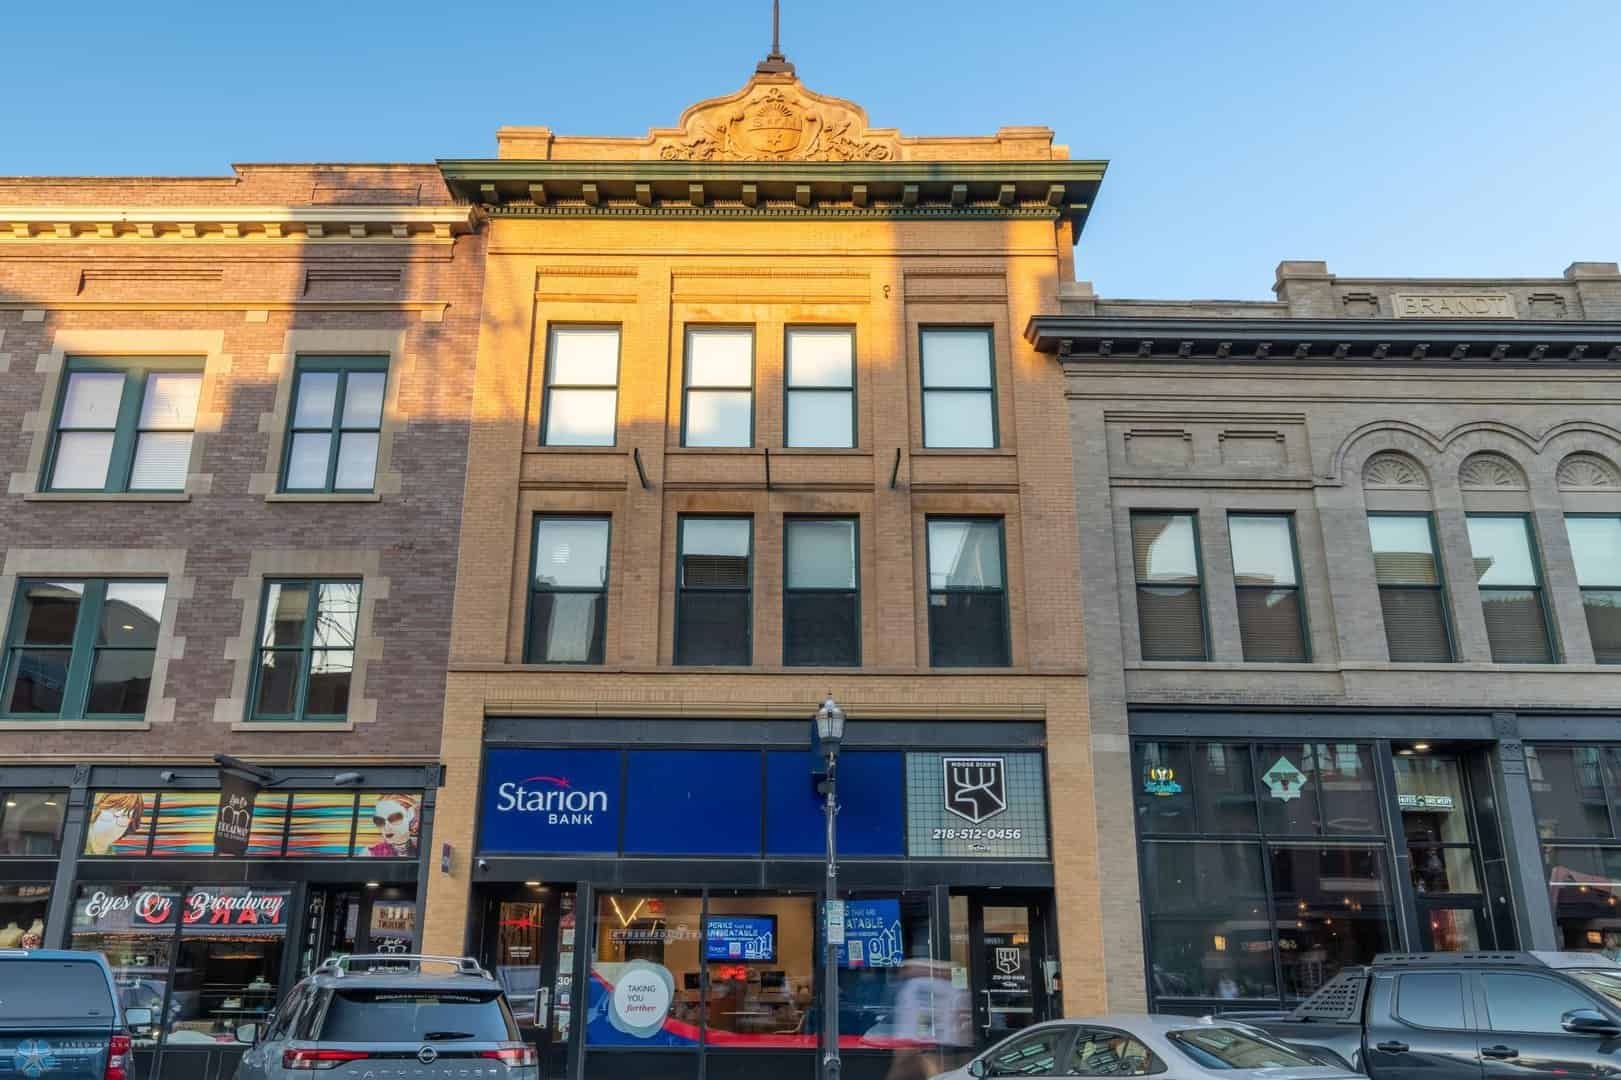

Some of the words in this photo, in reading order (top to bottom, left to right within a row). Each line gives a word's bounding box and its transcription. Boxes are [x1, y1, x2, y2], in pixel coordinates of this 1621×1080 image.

[1405, 298, 1504, 314] BRANDT
[497, 782, 608, 812] Starion
[548, 814, 593, 825] BANK
[932, 828, 1021, 840] 218-512-0456
[85, 891, 130, 918] Eyes
[135, 891, 173, 917] On
[189, 890, 285, 919] Broadway
[627, 984, 657, 992] TAKING
[627, 994, 644, 1002] YOU
[624, 1004, 657, 1013] further
